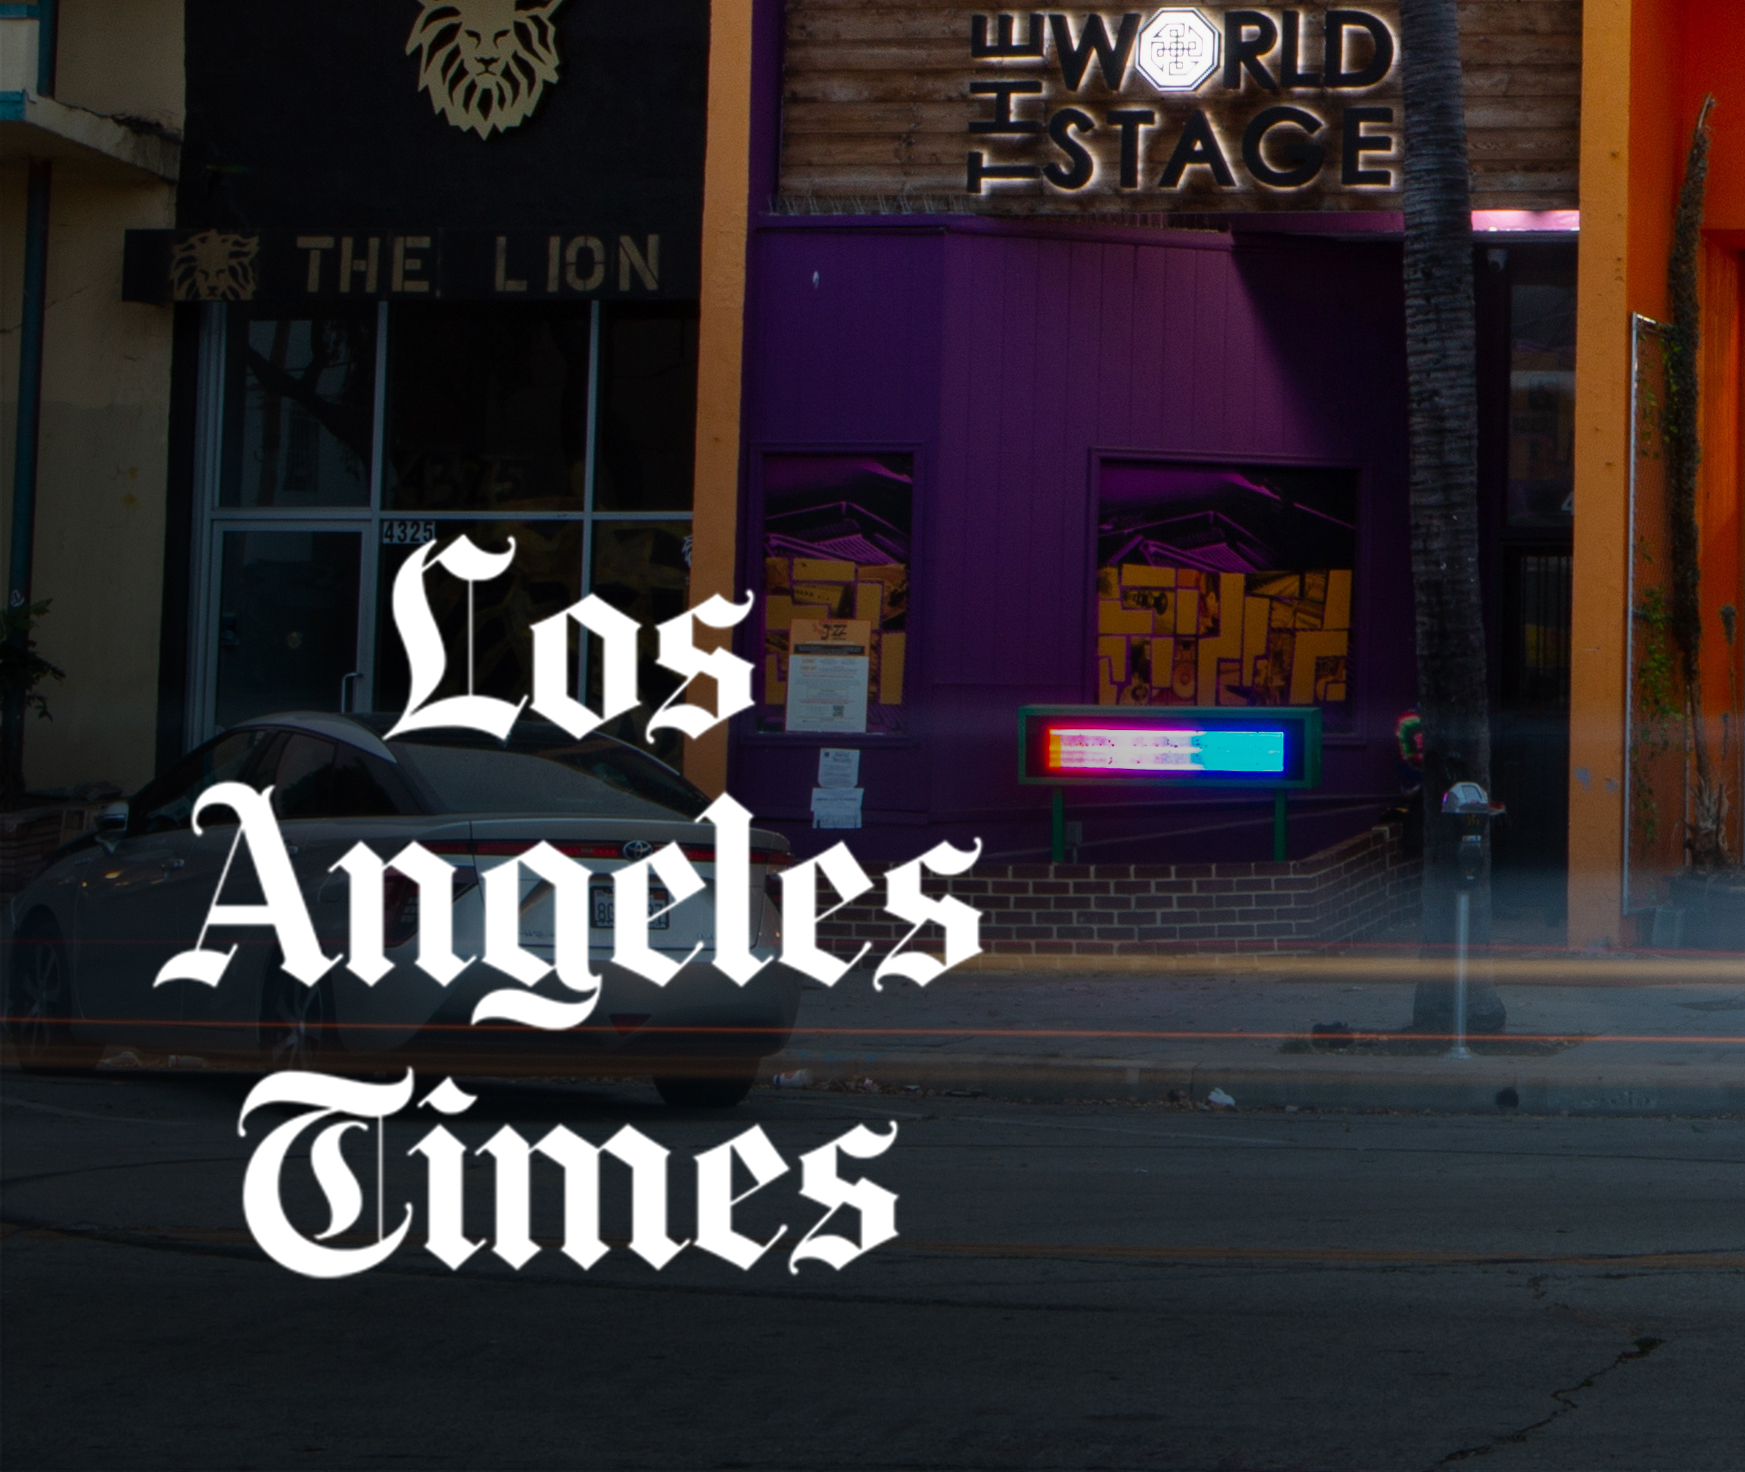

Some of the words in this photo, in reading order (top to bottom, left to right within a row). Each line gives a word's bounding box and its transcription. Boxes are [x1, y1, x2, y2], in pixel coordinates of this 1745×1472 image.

[967, 12, 1045, 194] THE
[1042, 105, 1397, 190] STAGE
[296, 235, 432, 294] THE
[494, 233, 661, 292] LION
[383, 521, 436, 543] 4325
